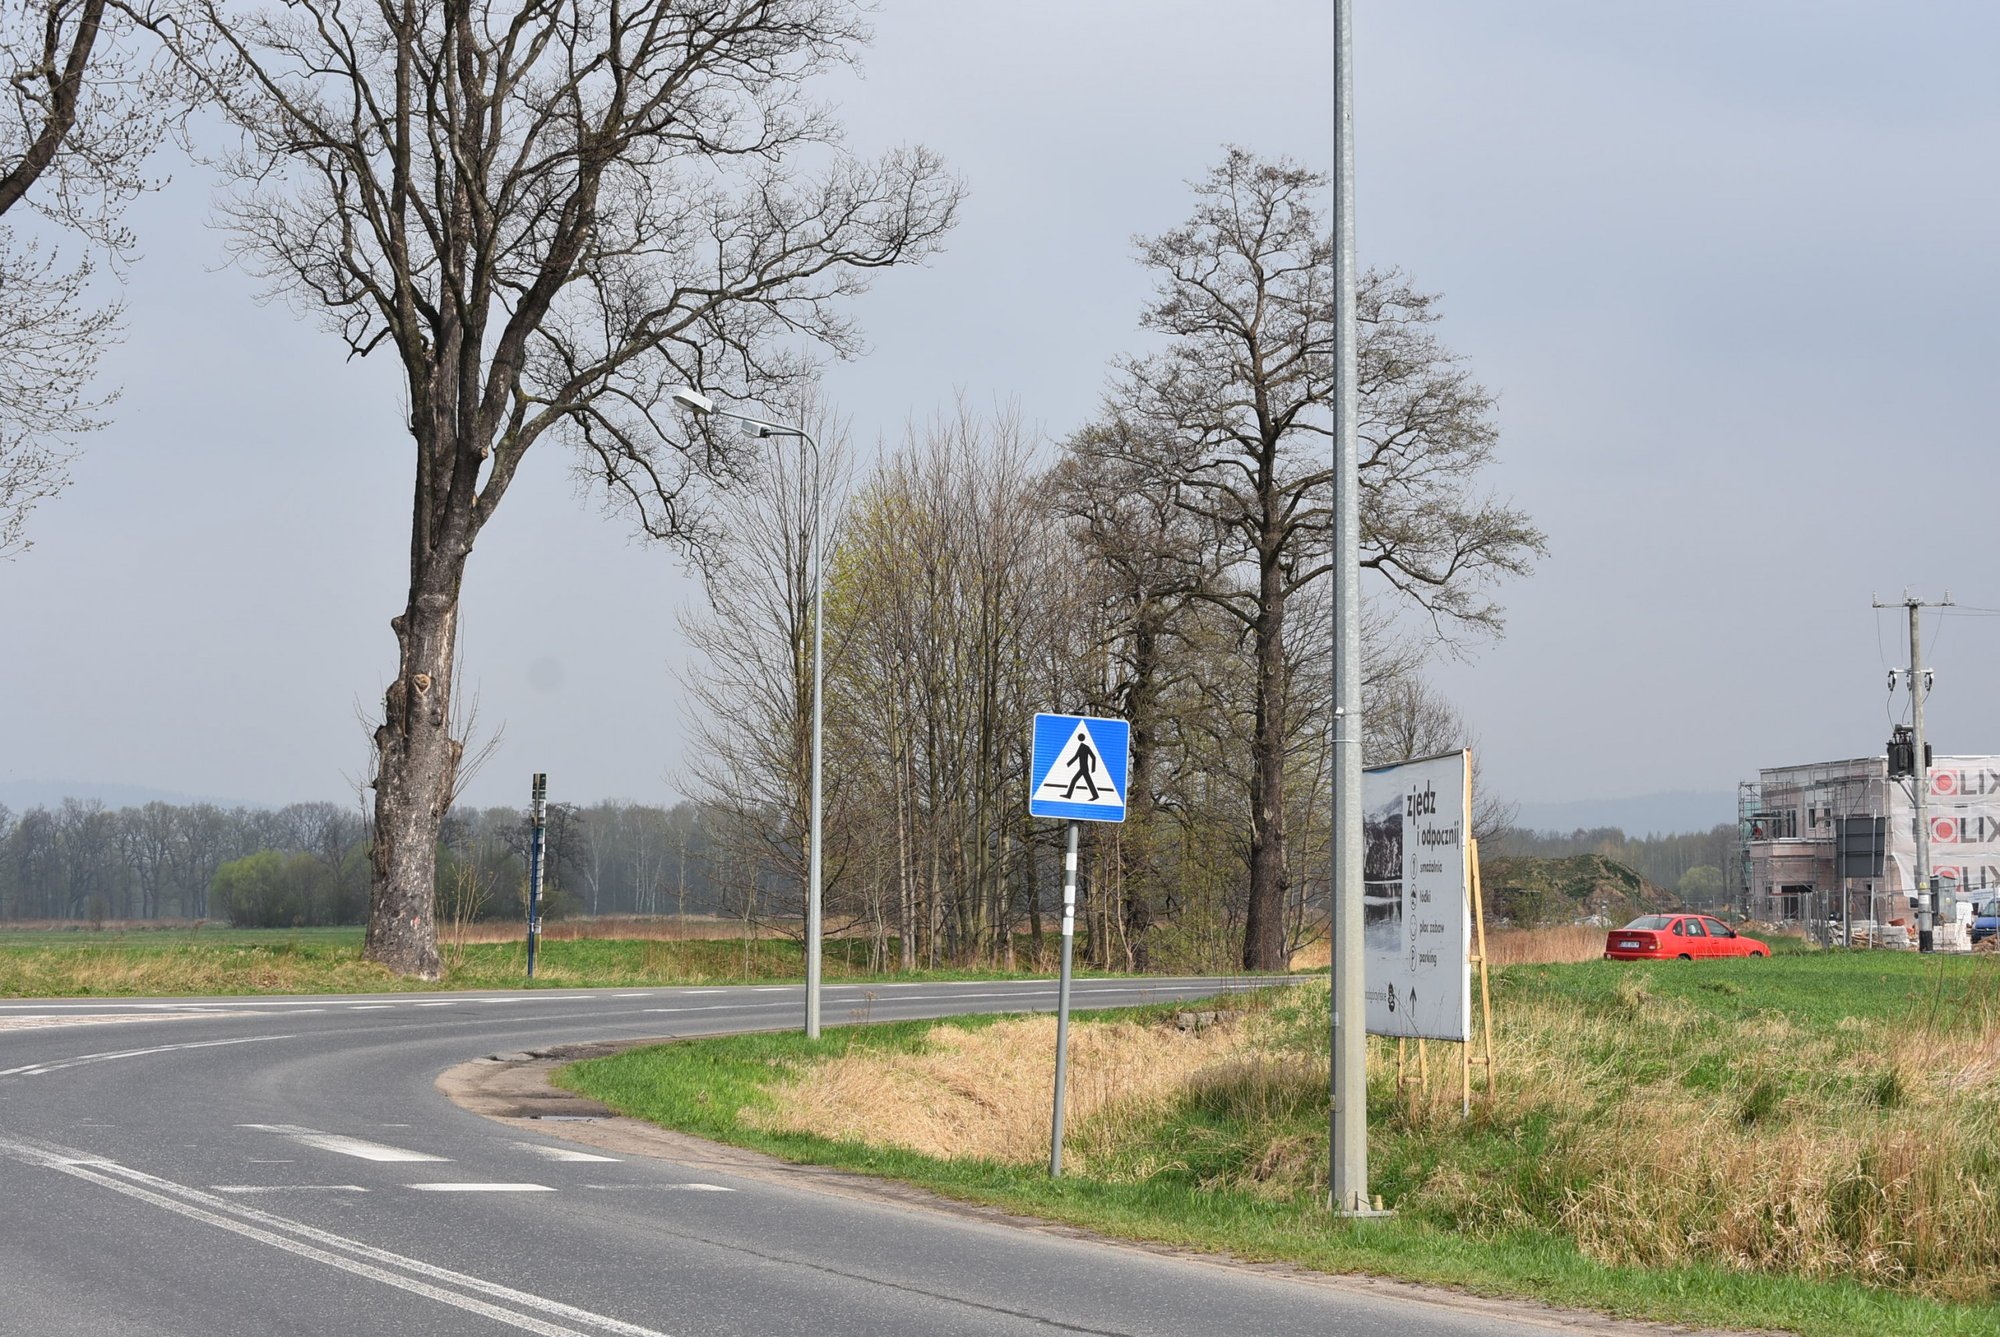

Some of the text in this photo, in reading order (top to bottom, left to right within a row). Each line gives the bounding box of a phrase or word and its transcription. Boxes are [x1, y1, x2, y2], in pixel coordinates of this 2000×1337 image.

[1914, 769, 2000, 795] OLIX
[1407, 779, 1436, 825] zjedz
[1416, 820, 1459, 851] i odpocznij
[1419, 949, 1437, 967] parking
